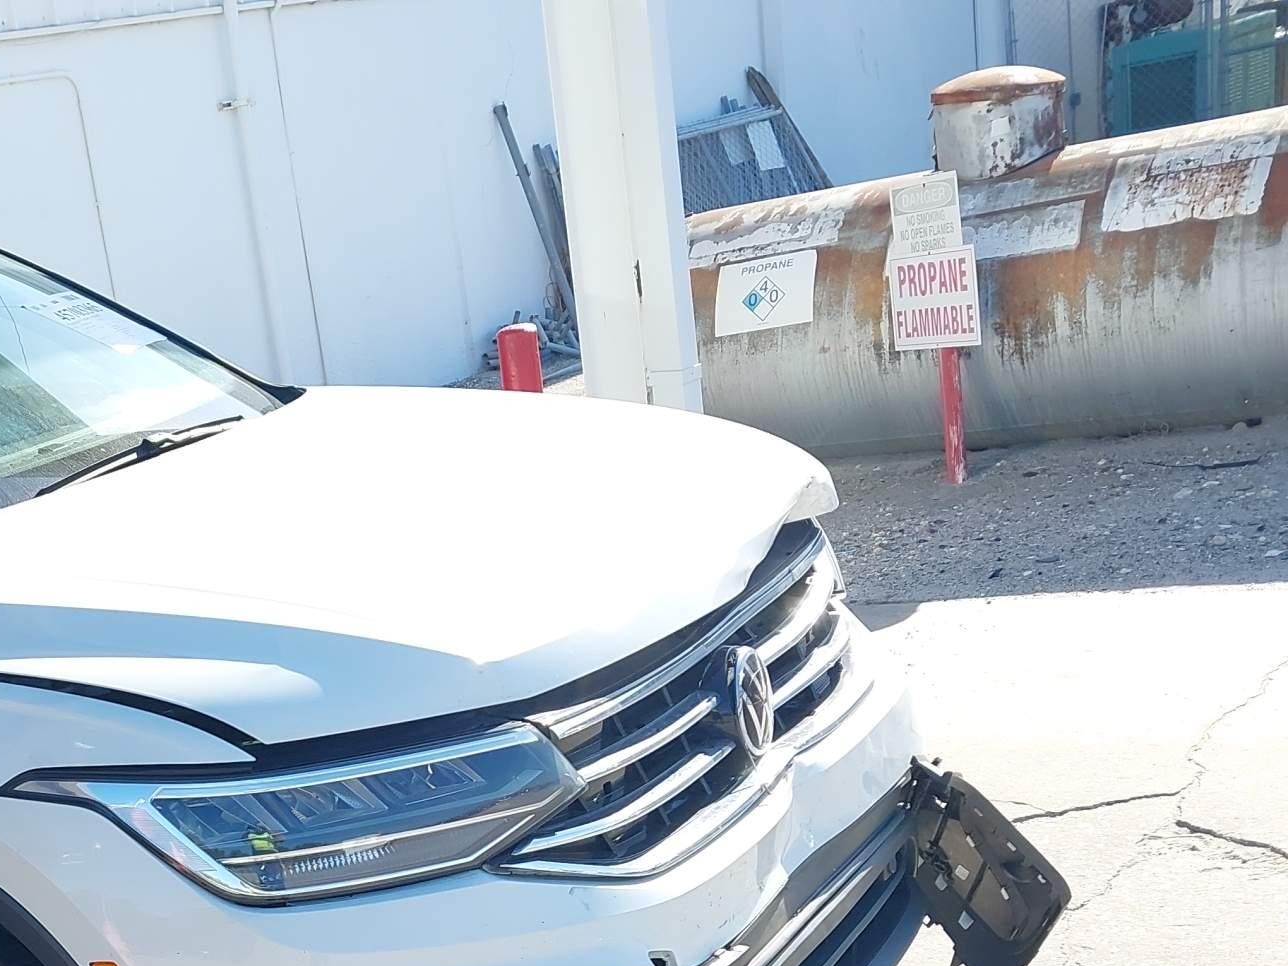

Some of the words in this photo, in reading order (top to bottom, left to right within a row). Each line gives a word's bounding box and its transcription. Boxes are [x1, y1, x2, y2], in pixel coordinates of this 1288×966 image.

[901, 187, 946, 208] DANGER
[906, 216, 915, 226] NO
[916, 209, 946, 225] SMOKING
[900, 230, 910, 240] NO
[911, 226, 928, 240] OPEN
[928, 222, 955, 237] FLAMES
[911, 241, 920, 253] NO
[921, 237, 946, 251] SPARKS
[741, 258, 794, 276] PROPANE
[759, 280, 769, 293] 4
[897, 257, 968, 298] PROPANE
[748, 293, 757, 307] 0
[769, 289, 778, 303] 0
[896, 304, 975, 339] FLAMMABLE
